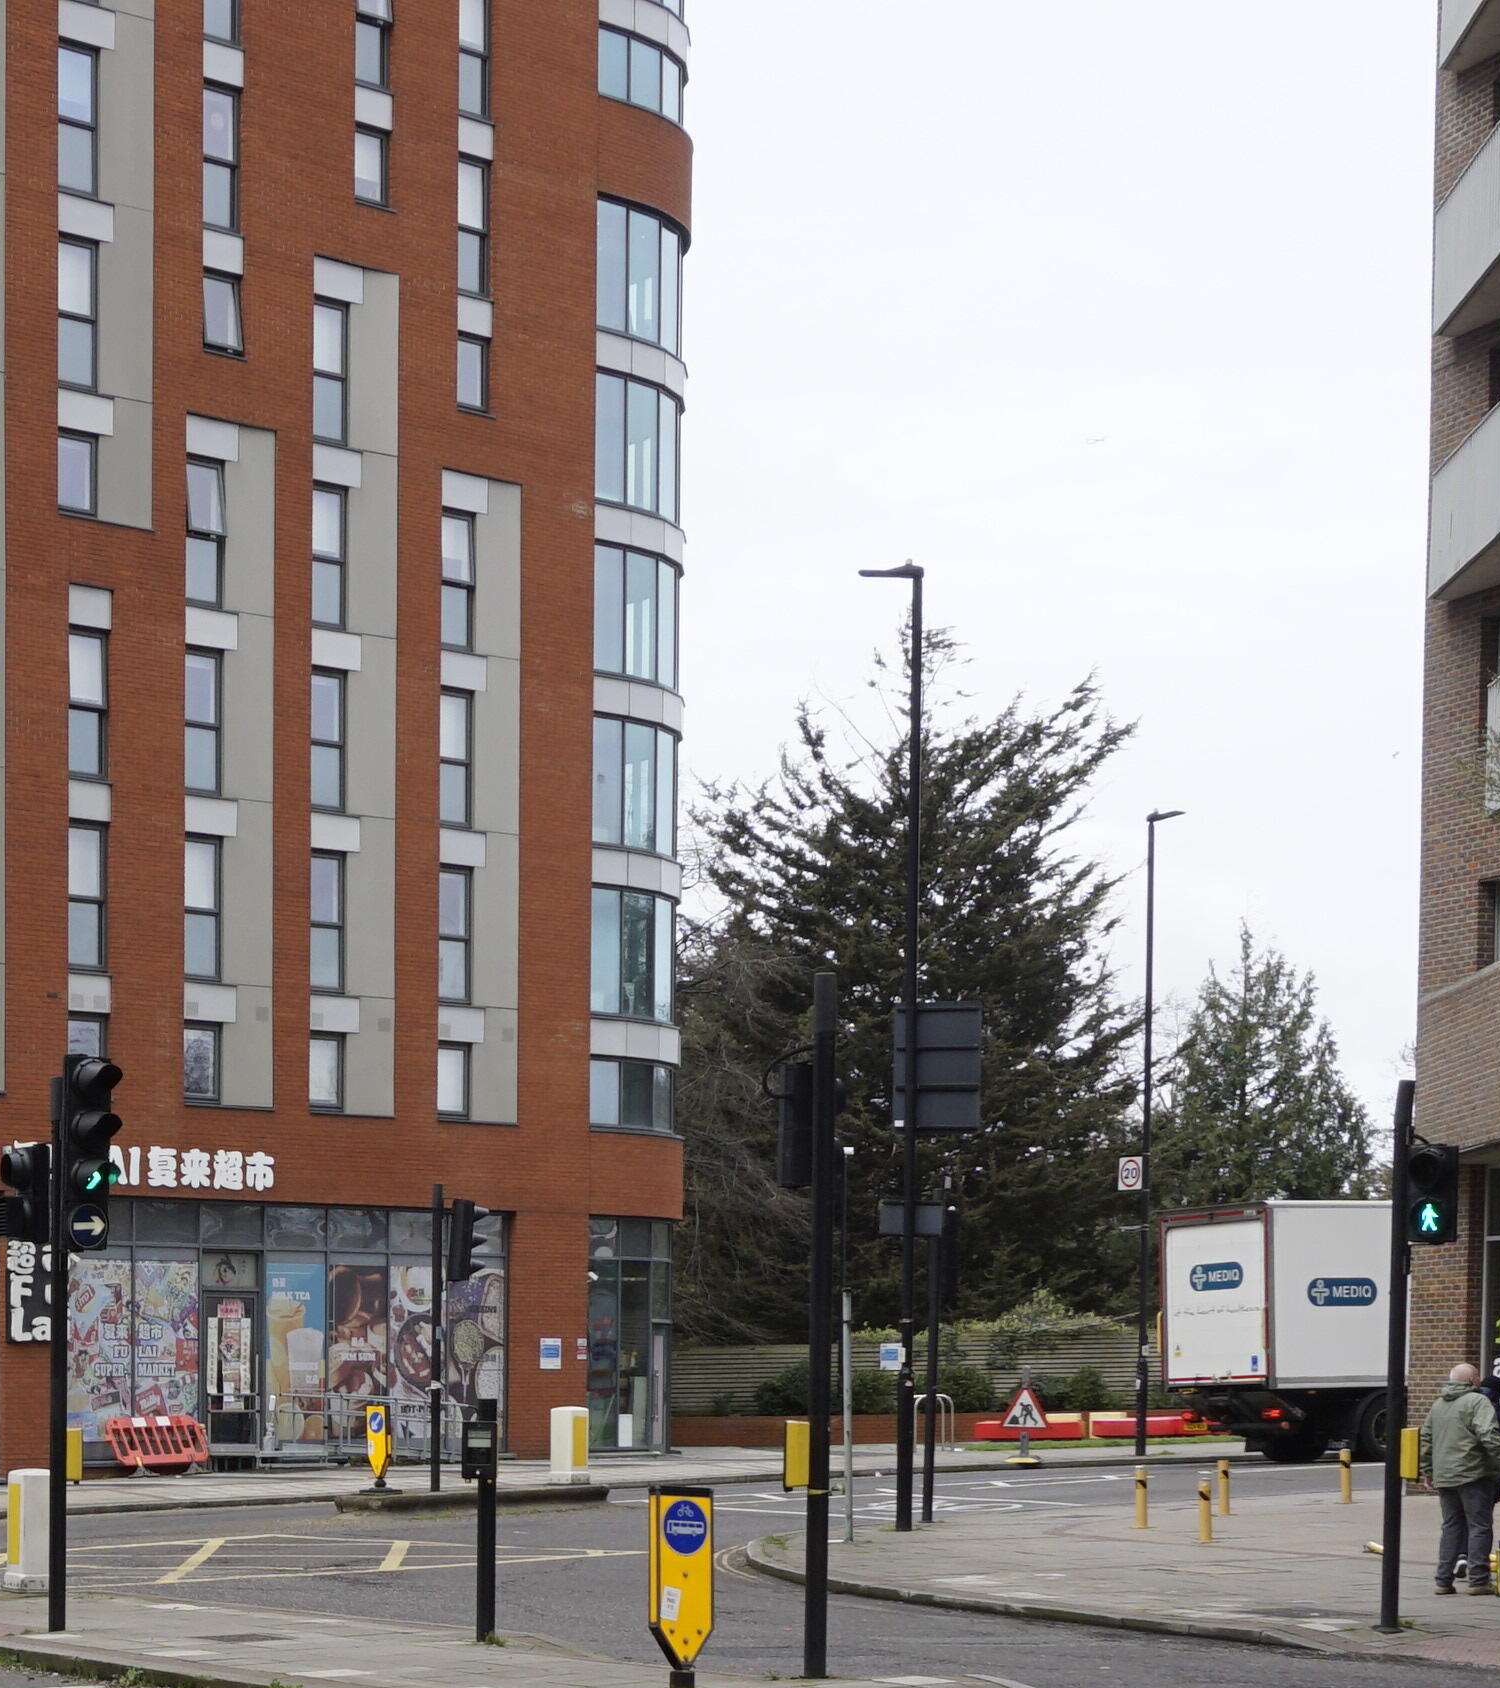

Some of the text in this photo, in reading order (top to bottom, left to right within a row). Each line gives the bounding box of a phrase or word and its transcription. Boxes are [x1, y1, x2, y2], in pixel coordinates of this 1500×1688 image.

[109, 1145, 276, 1192] AI 复来超市
[1124, 1167, 1138, 1180] 20
[1208, 1270, 1241, 1283] MEDIQ
[1332, 1285, 1373, 1299] MEDIQ
[137, 1363, 177, 1378] MARKET
